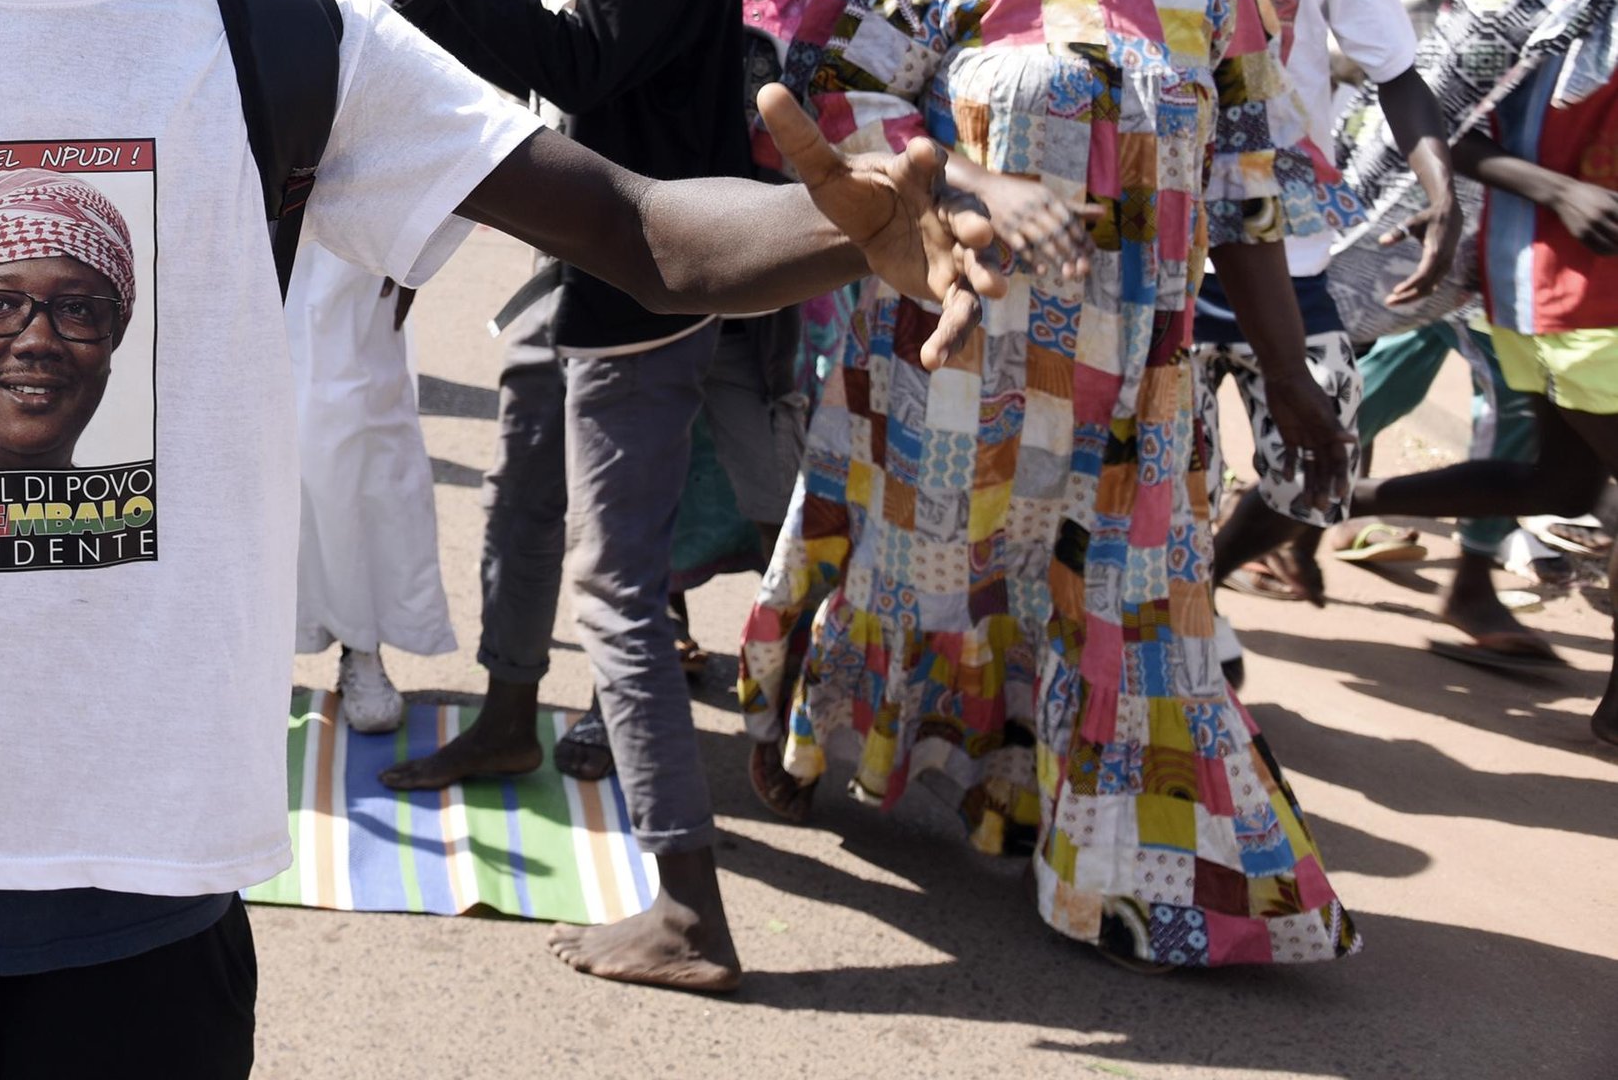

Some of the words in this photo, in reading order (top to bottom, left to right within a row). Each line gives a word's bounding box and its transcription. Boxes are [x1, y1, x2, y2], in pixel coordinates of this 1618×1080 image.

[40, 146, 122, 168] NPUDI
[25, 476, 54, 501] DI
[67, 469, 153, 501] POVO
